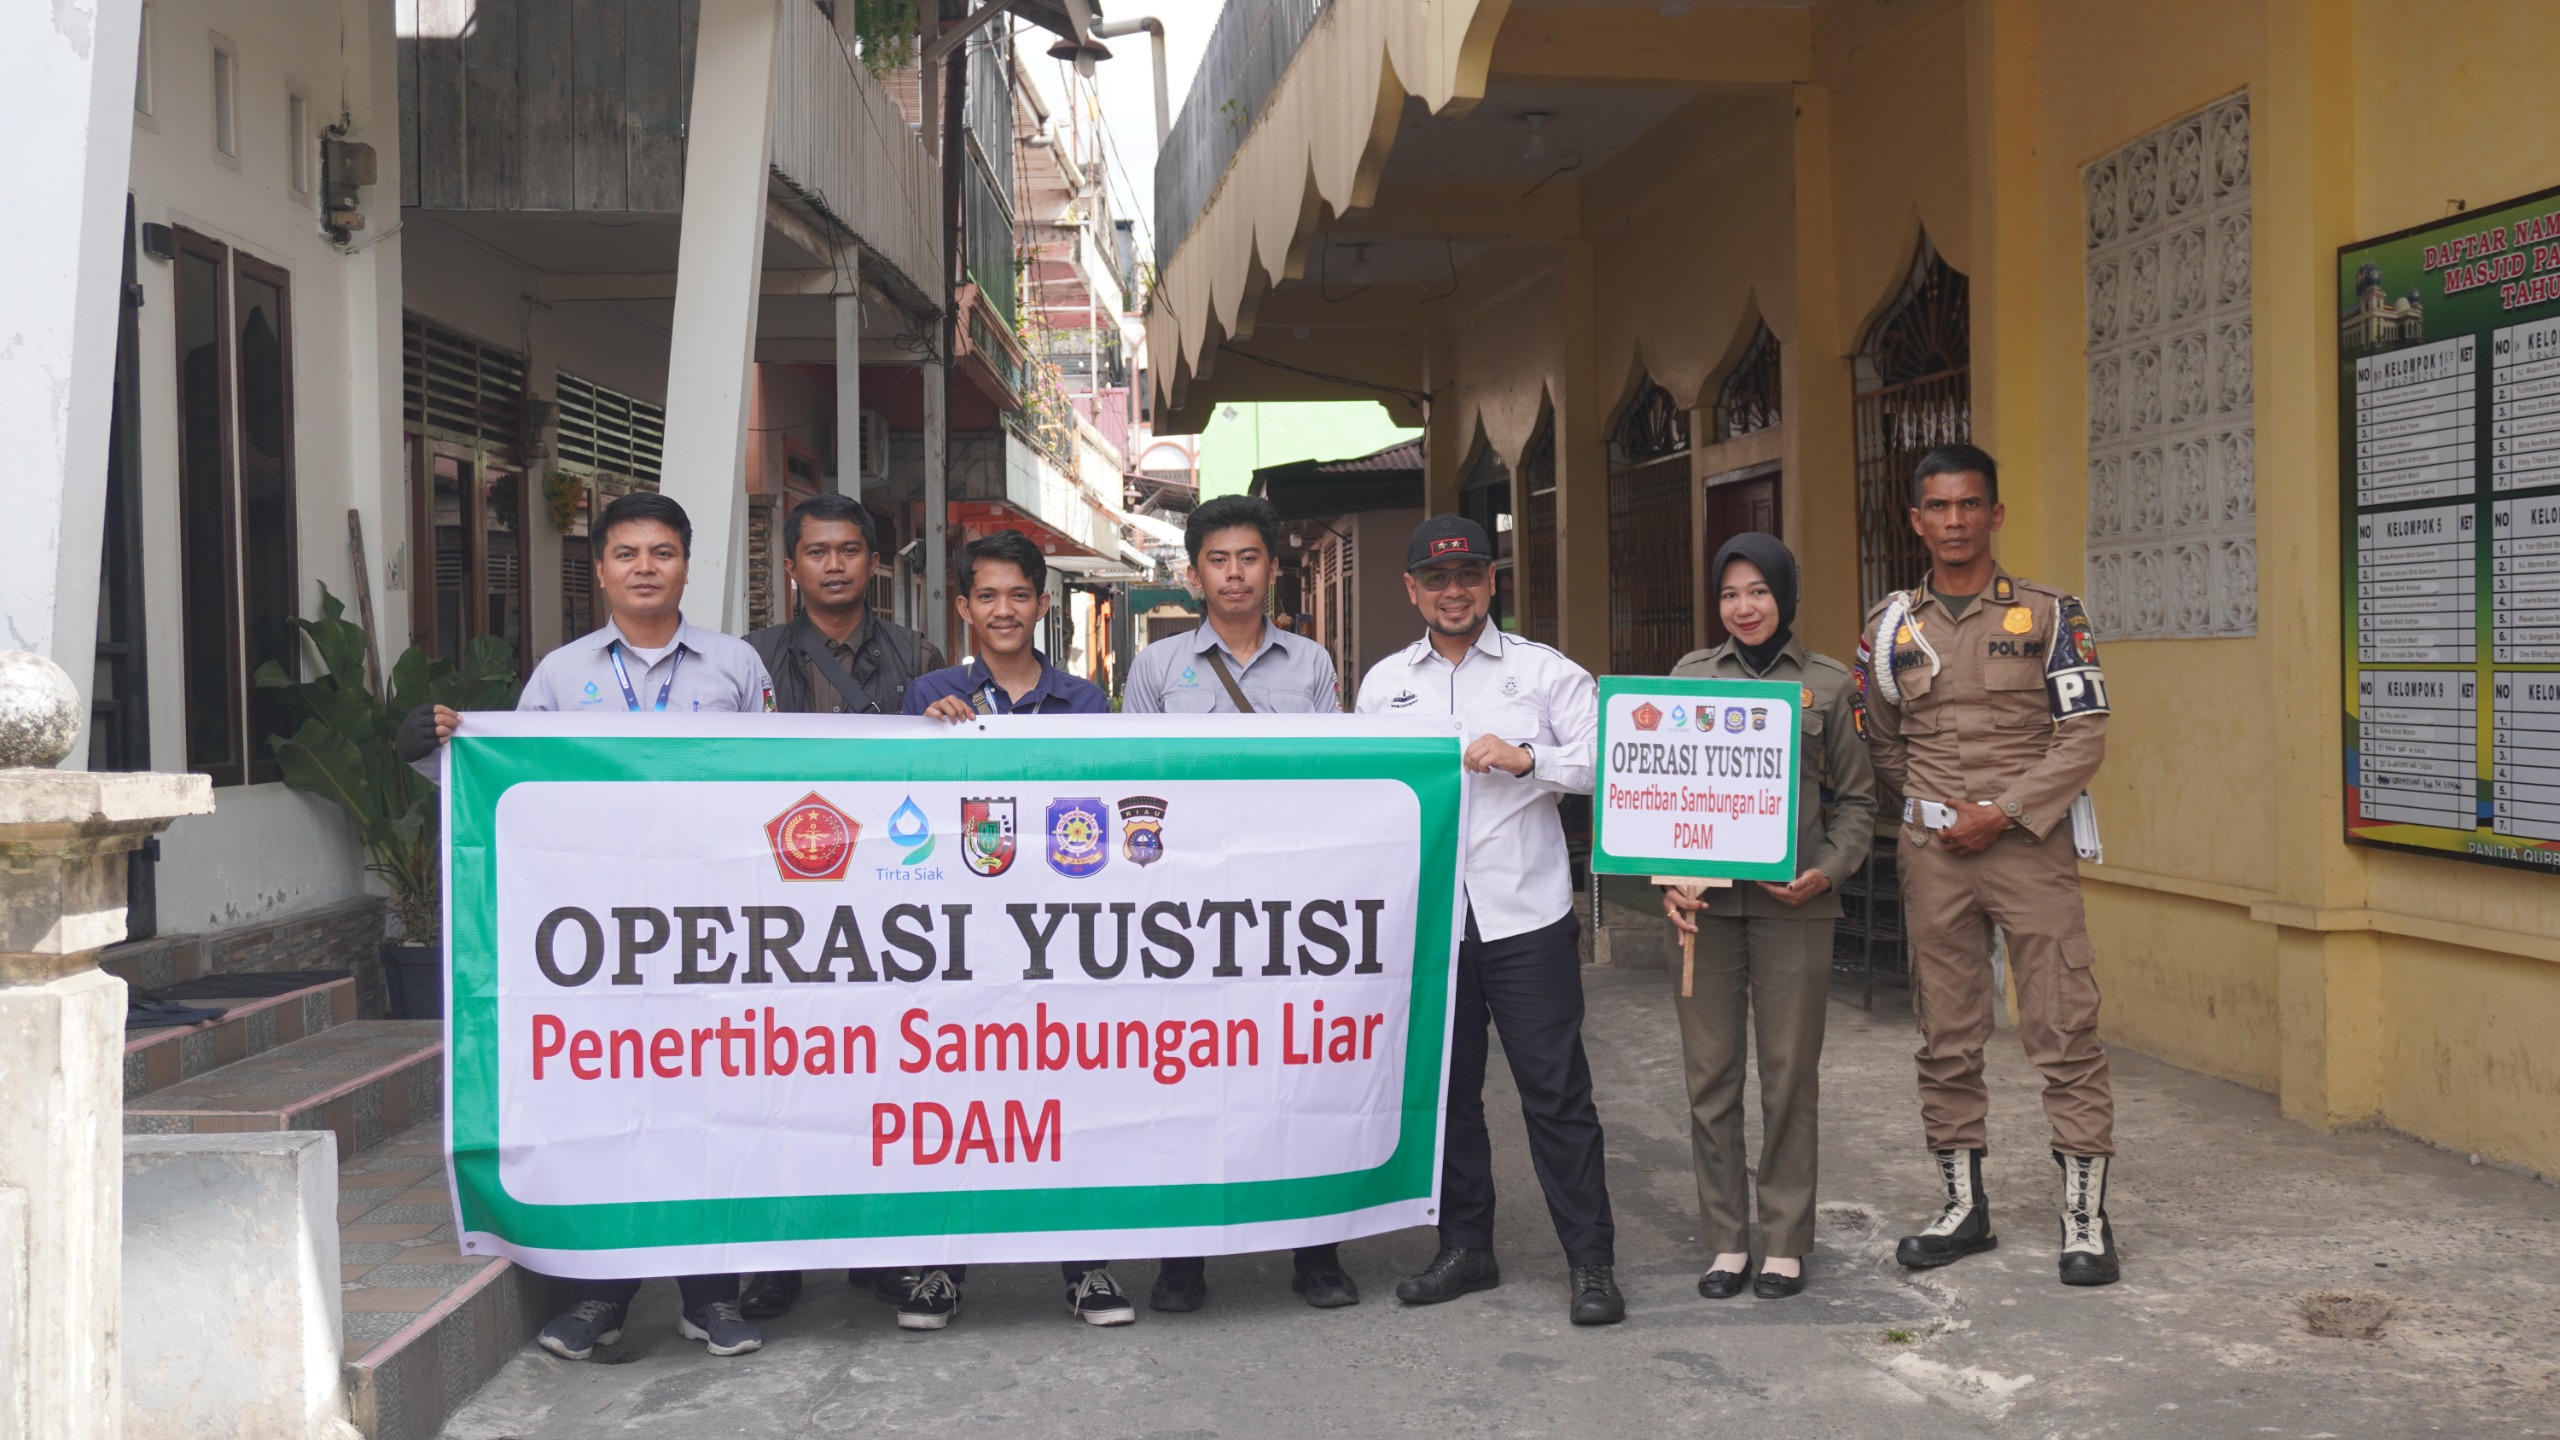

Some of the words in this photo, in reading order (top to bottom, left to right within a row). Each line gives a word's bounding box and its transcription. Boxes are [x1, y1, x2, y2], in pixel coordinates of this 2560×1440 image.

[2424, 227, 2506, 271] DAFTAR
[2445, 253, 2524, 294] MASJID
[2460, 346, 2473, 362] KET
[2496, 339, 2509, 355] NO
[2384, 353, 2435, 378] KELOMPOK
[2358, 368, 2370, 382] NO
[2460, 515, 2473, 530] KET
[2495, 512, 2509, 527] NO
[2531, 507, 2560, 525] KELO
[2359, 525, 2371, 539] NO
[2387, 519, 2434, 537] KELOMPOK
[1988, 640, 2018, 656] POL
[2023, 641, 2042, 657] PP
[2360, 682, 2372, 695] NO
[2387, 681, 2435, 698] KELOMPOK
[2438, 682, 2444, 698] 9
[2461, 683, 2474, 698] KET
[2496, 684, 2509, 699] NO
[1612, 742, 1698, 776] OPERASI
[1705, 745, 1782, 779] YUSTISI
[1609, 783, 1677, 811] Penertiban
[1681, 785, 1755, 821] Sambungan
[1758, 788, 1782, 816] Liar
[1125, 809, 1160, 817] RIAU
[1674, 822, 1713, 850] PDAM
[2468, 841, 2518, 860] PANITIA
[875, 867, 910, 881] Tirta
[914, 866, 944, 881] Siak
[536, 904, 972, 986] OPERASI
[1006, 899, 1384, 979] YUSTISI
[532, 1007, 876, 1080] Penertiban
[900, 1002, 1258, 1085] Sambungan
[1283, 999, 1384, 1064] Liar
[872, 1099, 1061, 1166] PDAM
